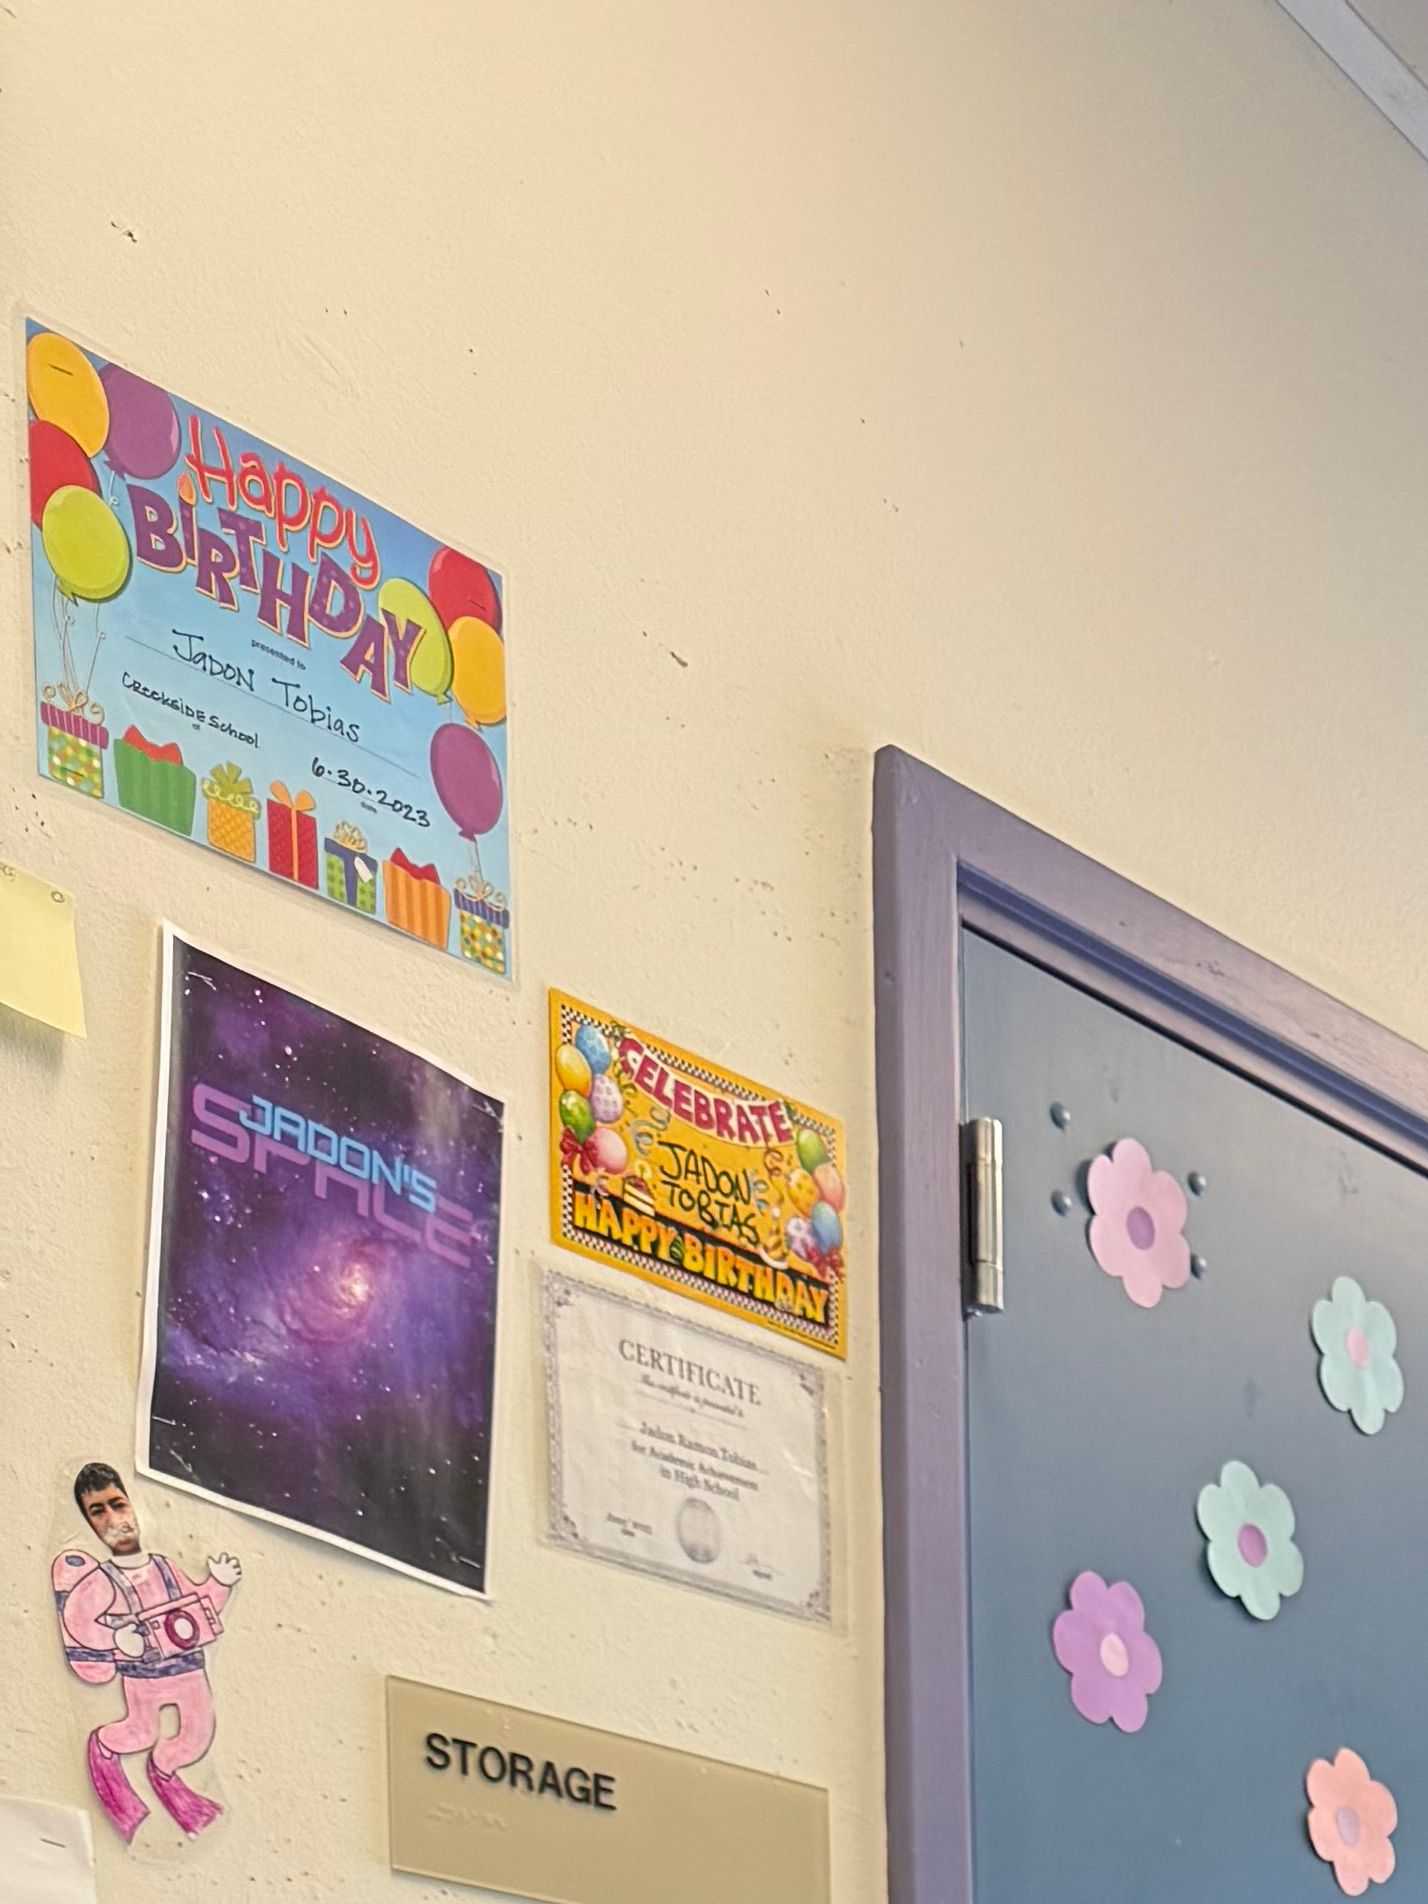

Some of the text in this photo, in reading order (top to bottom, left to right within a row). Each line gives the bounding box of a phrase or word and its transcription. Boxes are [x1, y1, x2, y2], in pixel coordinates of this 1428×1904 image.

[184, 414, 380, 590] Happy
[251, 639, 307, 671] presented to
[271, 677, 360, 743] Tobias
[618, 1036, 796, 1145] CELEBRATE
[239, 1094, 437, 1214] JADON'S
[657, 1140, 752, 1206] JADON
[661, 1180, 760, 1246] TOBIAS
[573, 1193, 830, 1325] HAPPY BIRTHDAY
[618, 1338, 762, 1405] CERTIFICATE
[425, 1732, 617, 1811] STORAGE
